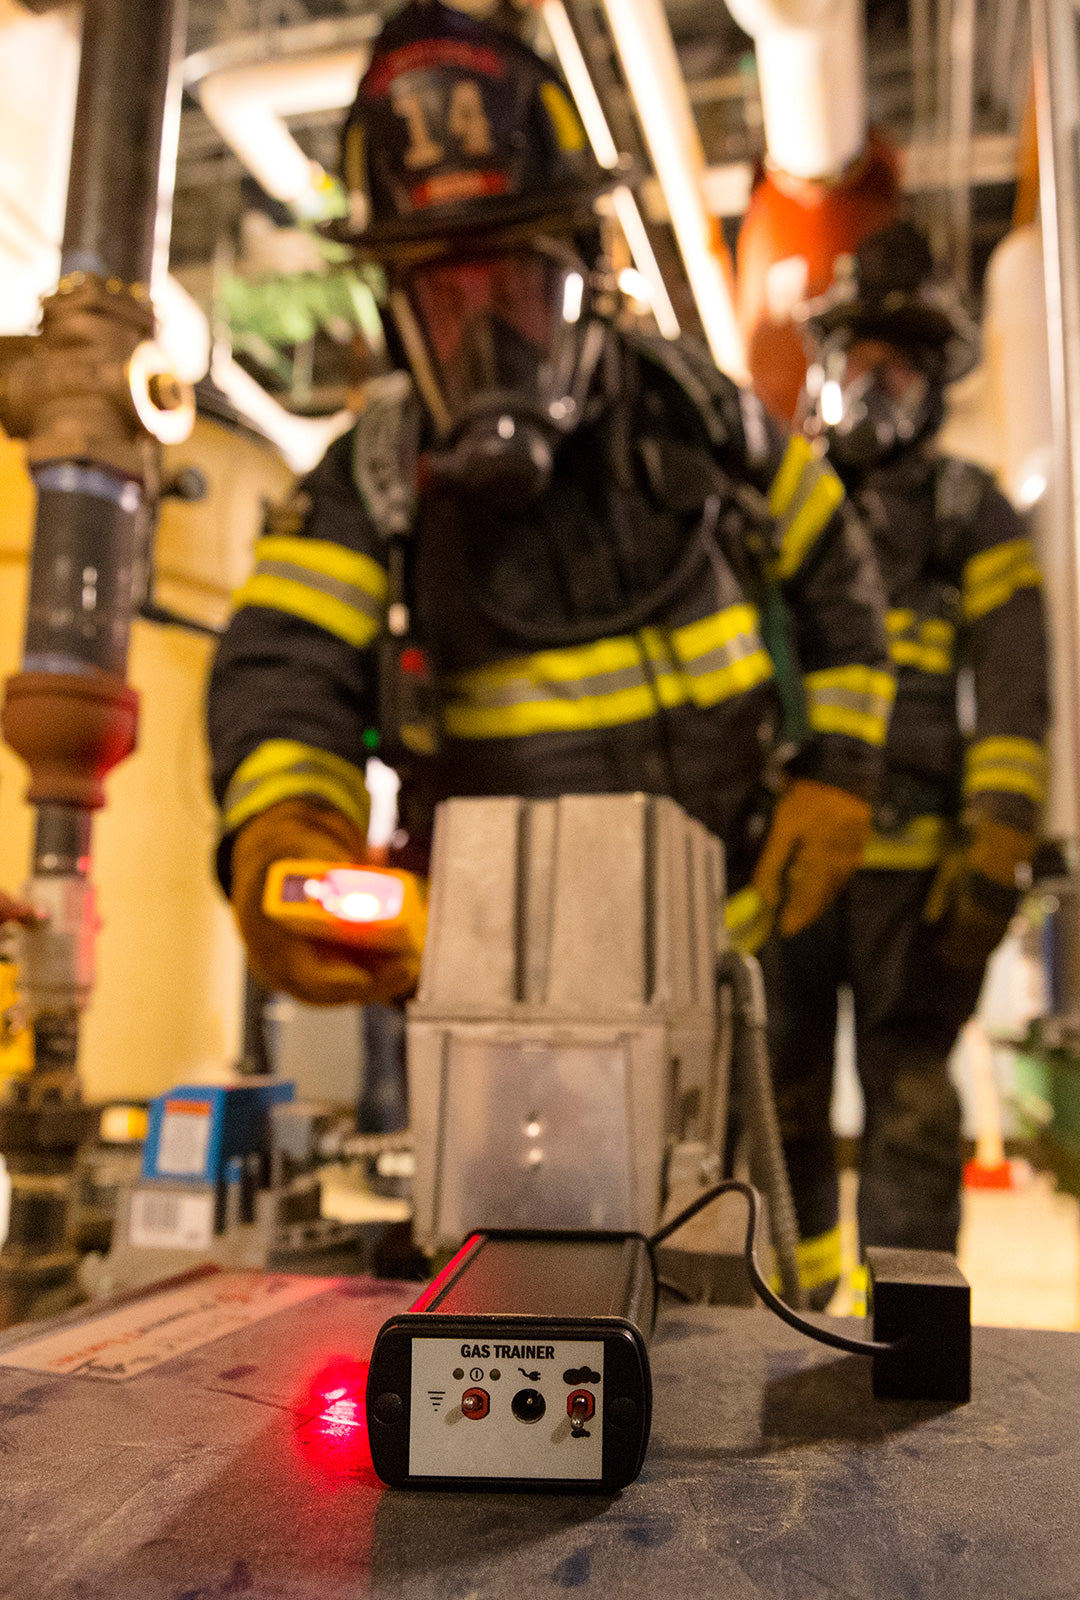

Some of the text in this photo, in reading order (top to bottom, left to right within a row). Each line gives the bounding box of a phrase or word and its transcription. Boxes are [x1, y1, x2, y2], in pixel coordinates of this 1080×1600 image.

[391, 78, 492, 171] 14
[461, 1344, 555, 1359] GAS TRAINER
